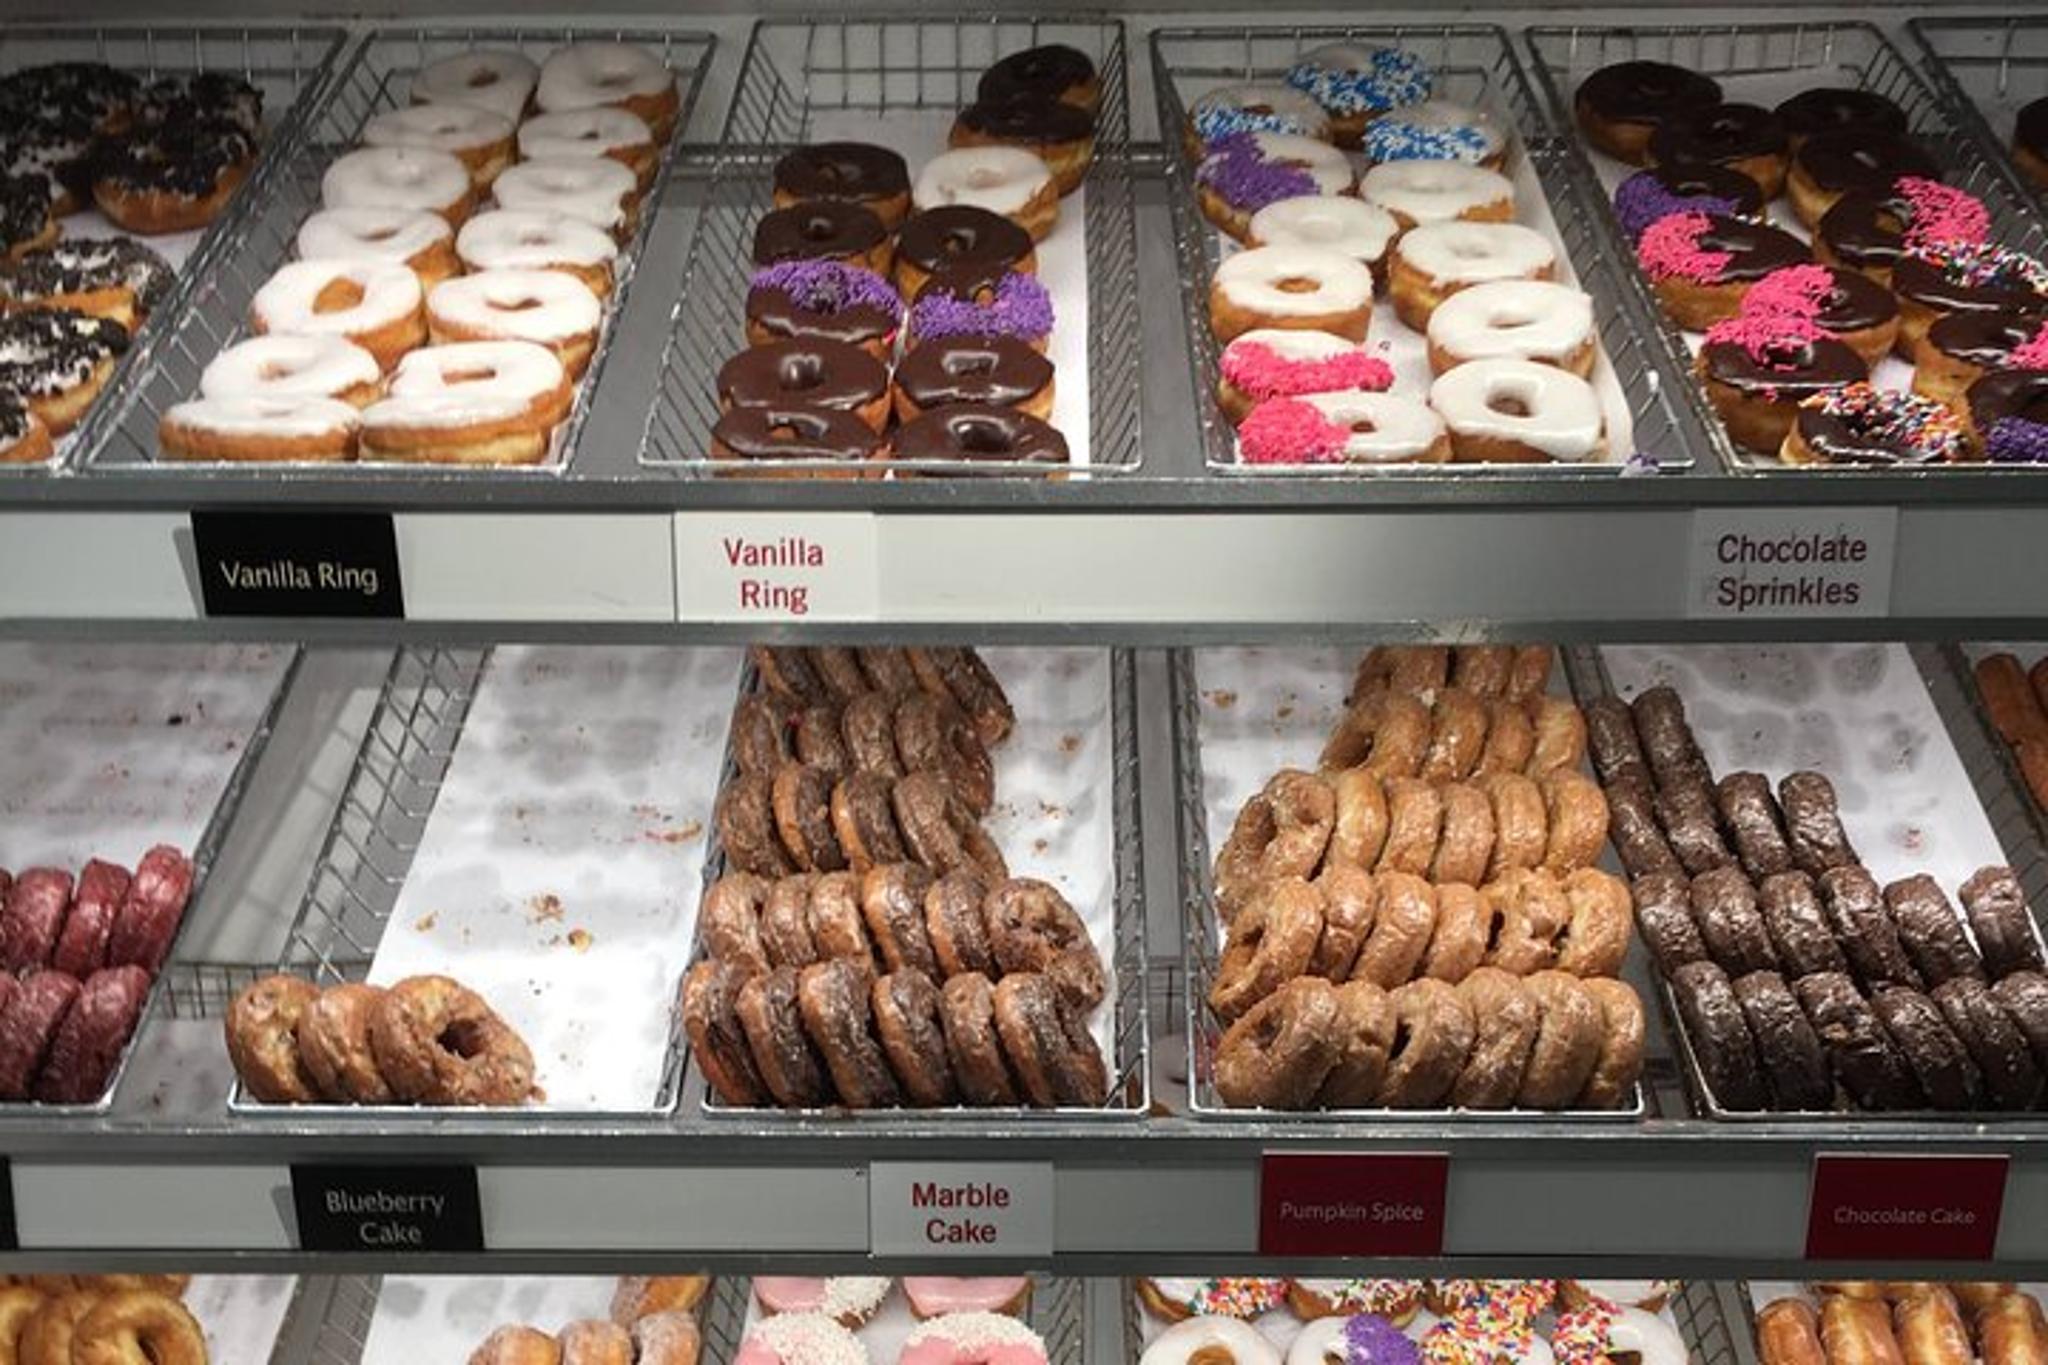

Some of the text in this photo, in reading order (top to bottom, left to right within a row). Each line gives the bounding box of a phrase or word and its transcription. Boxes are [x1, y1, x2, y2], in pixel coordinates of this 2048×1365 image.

[724, 538, 825, 567] Vanilla
[1718, 532, 1867, 565] Chocolate
[221, 560, 378, 596] Vanilla Ring
[741, 581, 808, 614] Ring
[1718, 576, 1860, 612] Sprinkles
[326, 1190, 445, 1217] Blueberry
[912, 1183, 1010, 1208] Marble
[1280, 1202, 1425, 1226] Pumpkin Spice
[1835, 1206, 1977, 1226] Chocolate Cake
[359, 1221, 422, 1245] Cake
[927, 1219, 997, 1244] Cake
